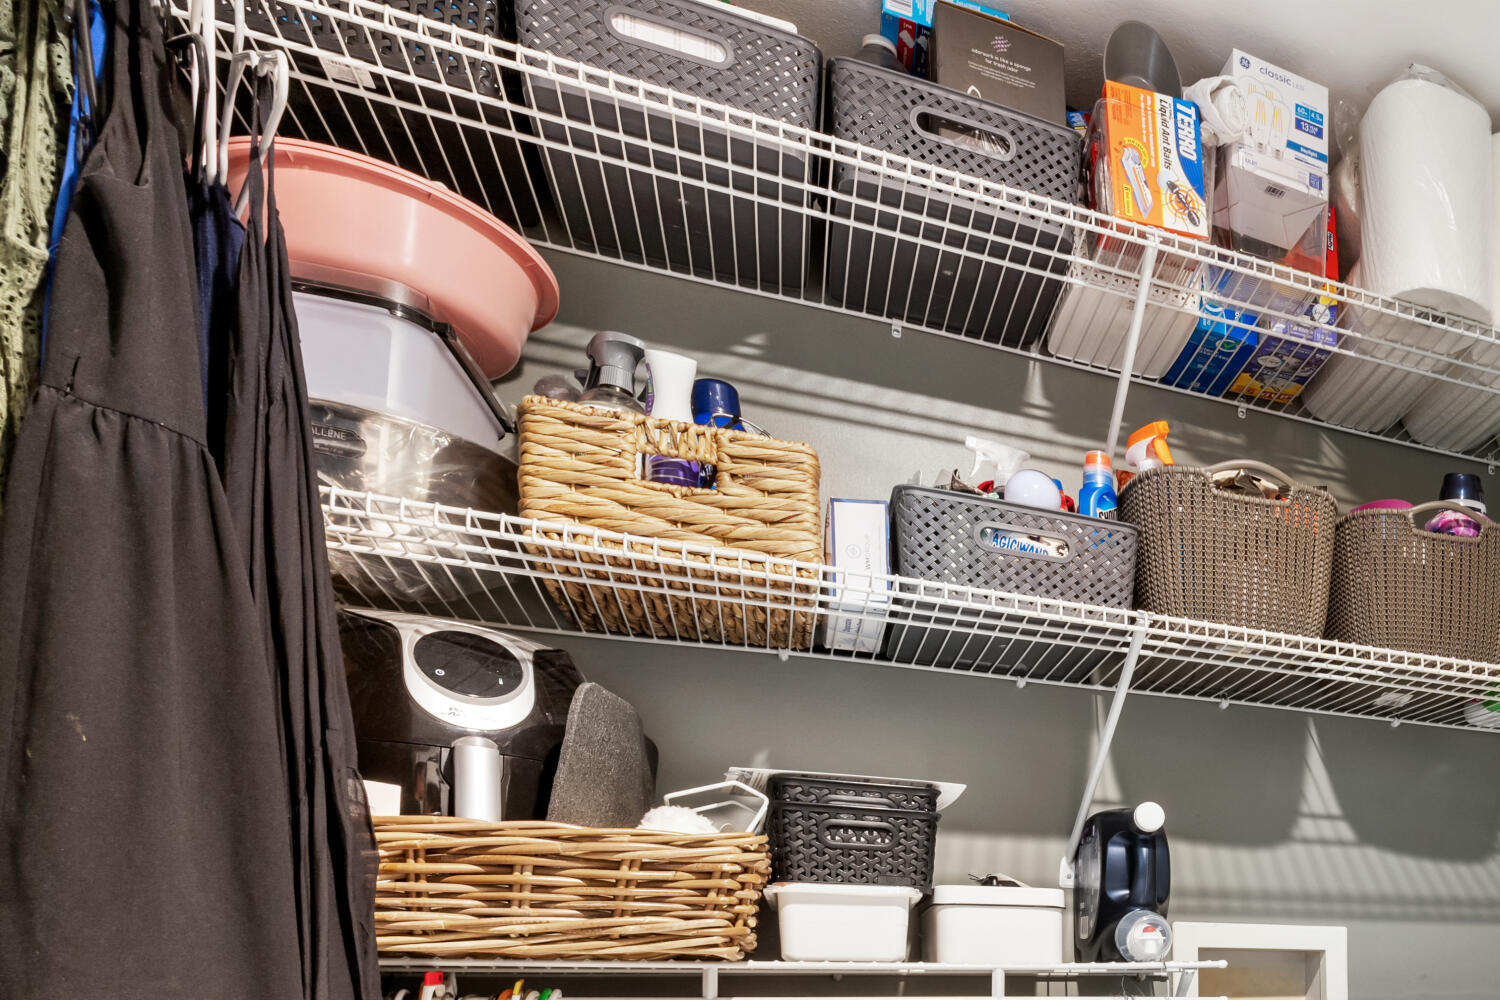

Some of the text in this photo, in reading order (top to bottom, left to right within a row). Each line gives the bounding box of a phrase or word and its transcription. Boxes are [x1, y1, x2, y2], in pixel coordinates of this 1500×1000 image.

[1259, 65, 1292, 87] classic
[1159, 98, 1171, 129] Liquid
[1161, 128, 1172, 147] Ant
[1176, 102, 1197, 162] TERRO
[1300, 121, 1309, 132] 13
[1162, 147, 1172, 171] Baits
